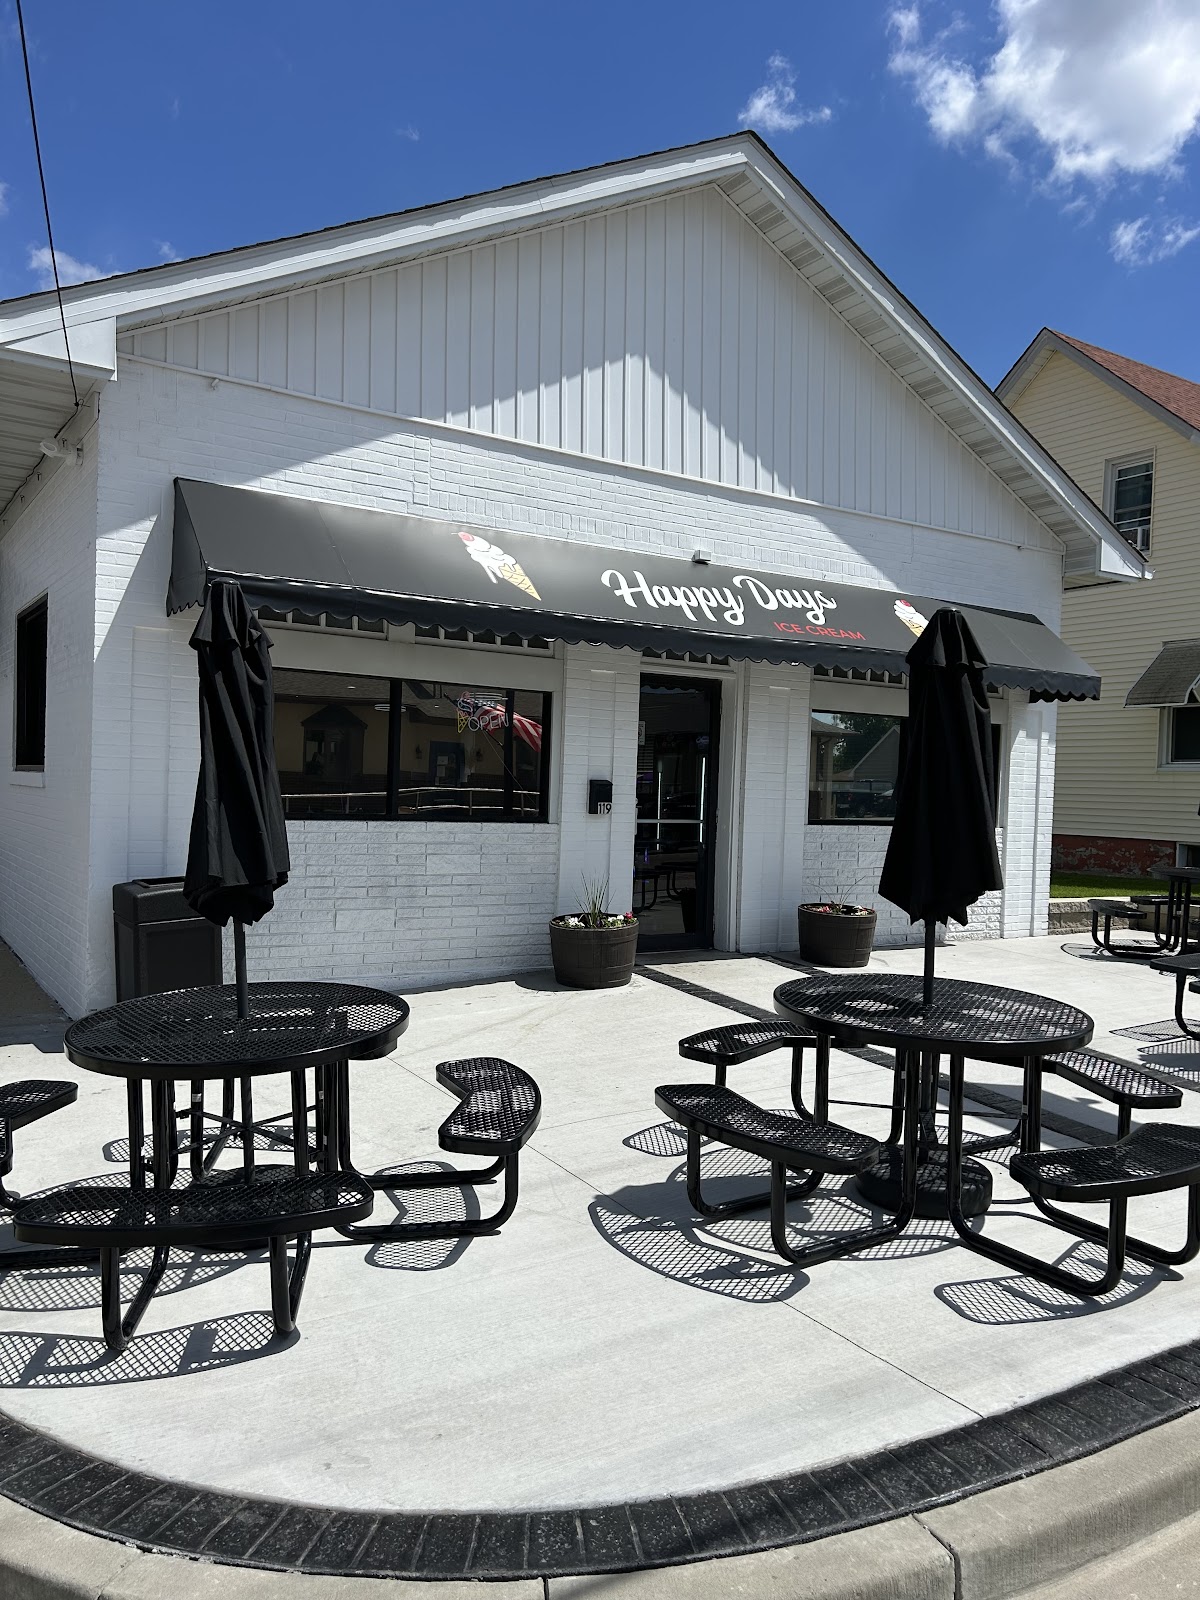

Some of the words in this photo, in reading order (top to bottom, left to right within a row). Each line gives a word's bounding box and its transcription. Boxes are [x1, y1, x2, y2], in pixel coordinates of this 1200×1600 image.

[600, 569, 745, 625] Happy
[732, 575, 837, 625] Days
[774, 622, 804, 634] ICE
[805, 625, 866, 640] CREAM
[468, 713, 509, 731] OPEN
[598, 803, 612, 814] 119
